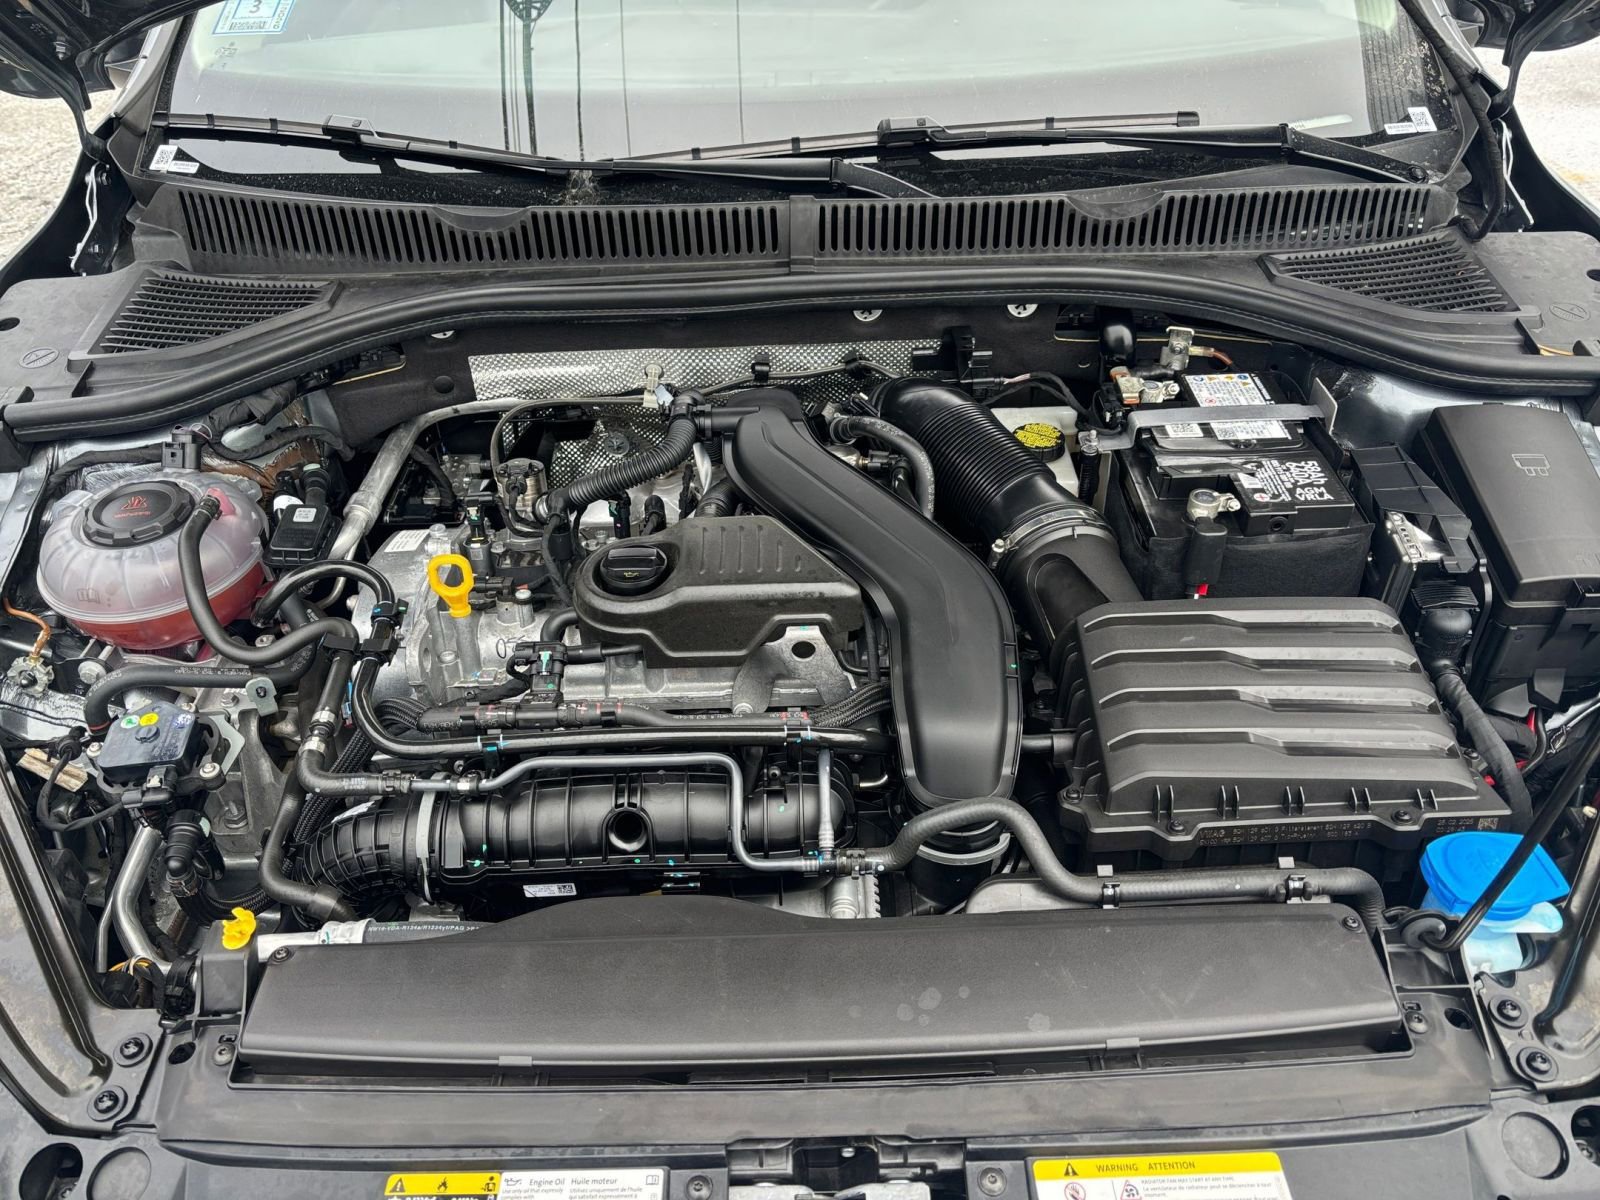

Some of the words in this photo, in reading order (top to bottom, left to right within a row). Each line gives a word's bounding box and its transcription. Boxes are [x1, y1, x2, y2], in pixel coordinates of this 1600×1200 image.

[1301, 461, 1328, 485] 58Ah
[1296, 486, 1327, 495] AGM
[1294, 493, 1334, 501] VRLA
[1096, 1163, 1138, 1173] WARNING
[1148, 1161, 1195, 1171] ATTENTION
[529, 1178, 553, 1187] Engine
[555, 1177, 565, 1185] Oil
